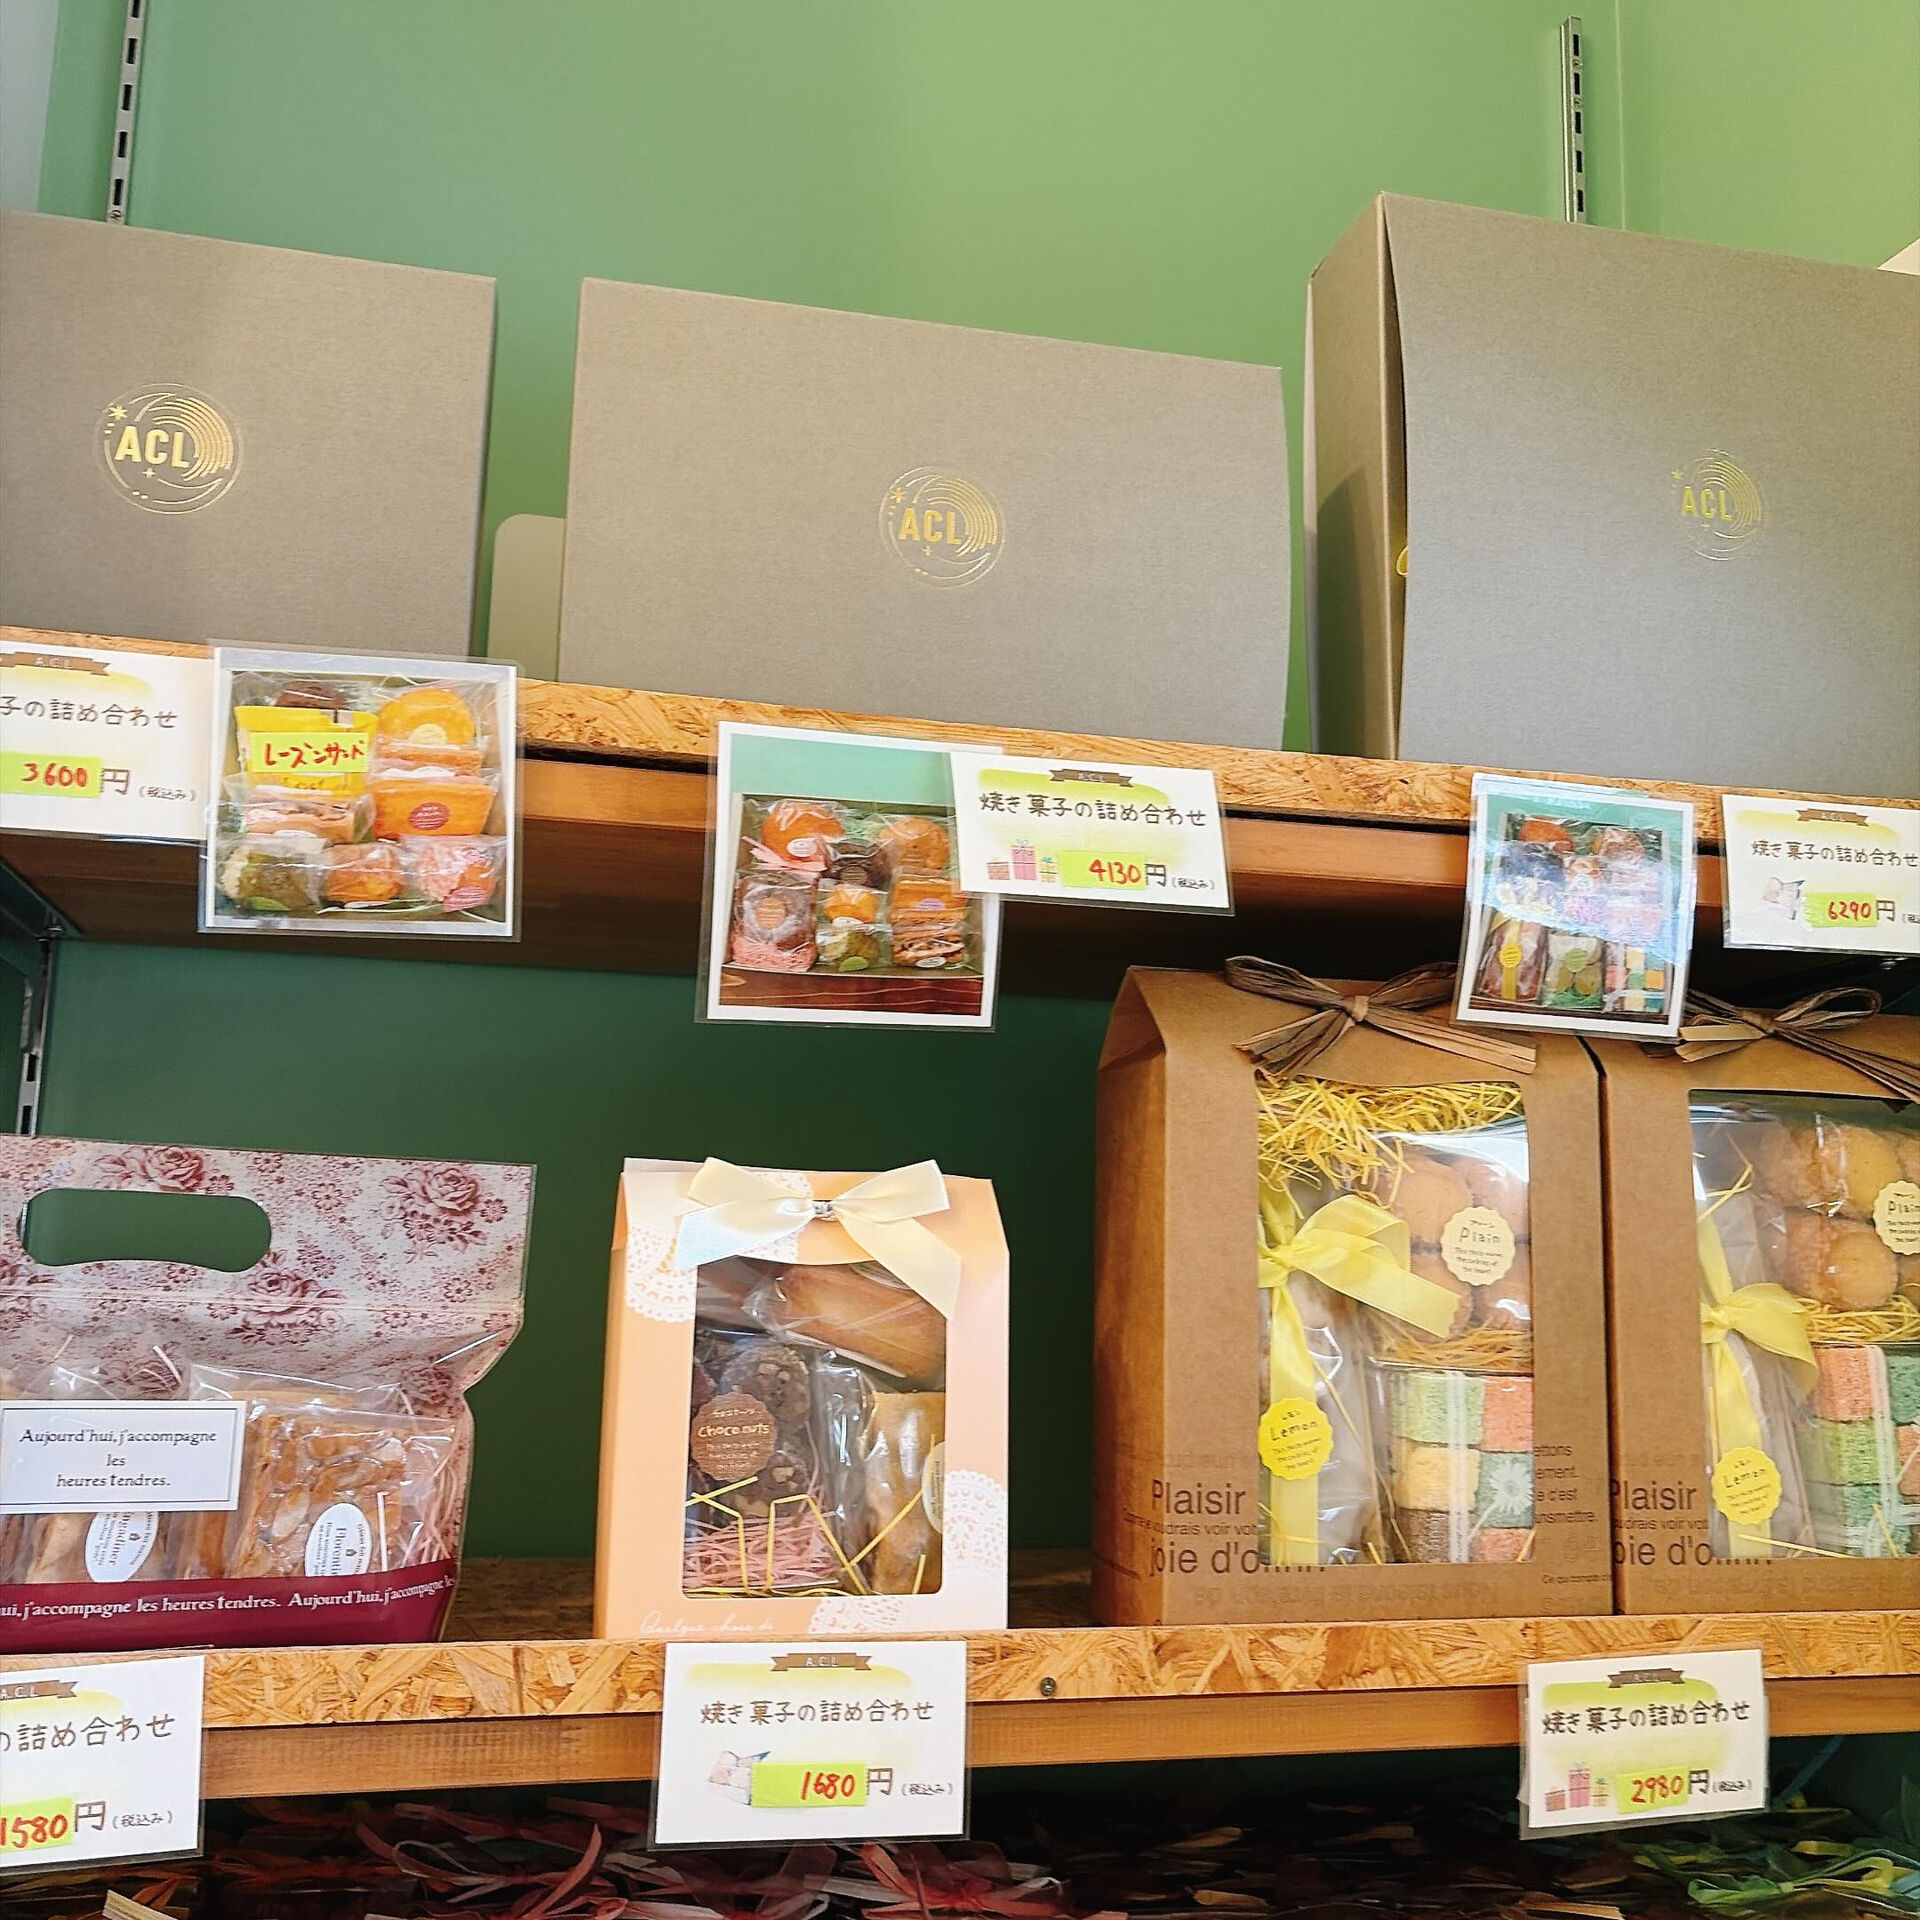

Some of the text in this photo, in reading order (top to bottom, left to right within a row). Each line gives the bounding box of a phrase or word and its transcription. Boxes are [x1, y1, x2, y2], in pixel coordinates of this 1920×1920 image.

[114, 425, 190, 468] ACL
[1681, 485, 1732, 521] ACL
[898, 507, 962, 545] ACL
[106, 1453, 126, 1467] les
[56, 1474, 172, 1488] heures tendres.
[1151, 1479, 1246, 1514] Plaisir
[1150, 1537, 1198, 1577] joie
[22, 1601, 130, 1621] j'accompagne
[137, 1598, 159, 1613] les
[162, 1597, 214, 1612] heures
[700, 1699, 934, 1725] 焼き菓子の詰め合わせ
